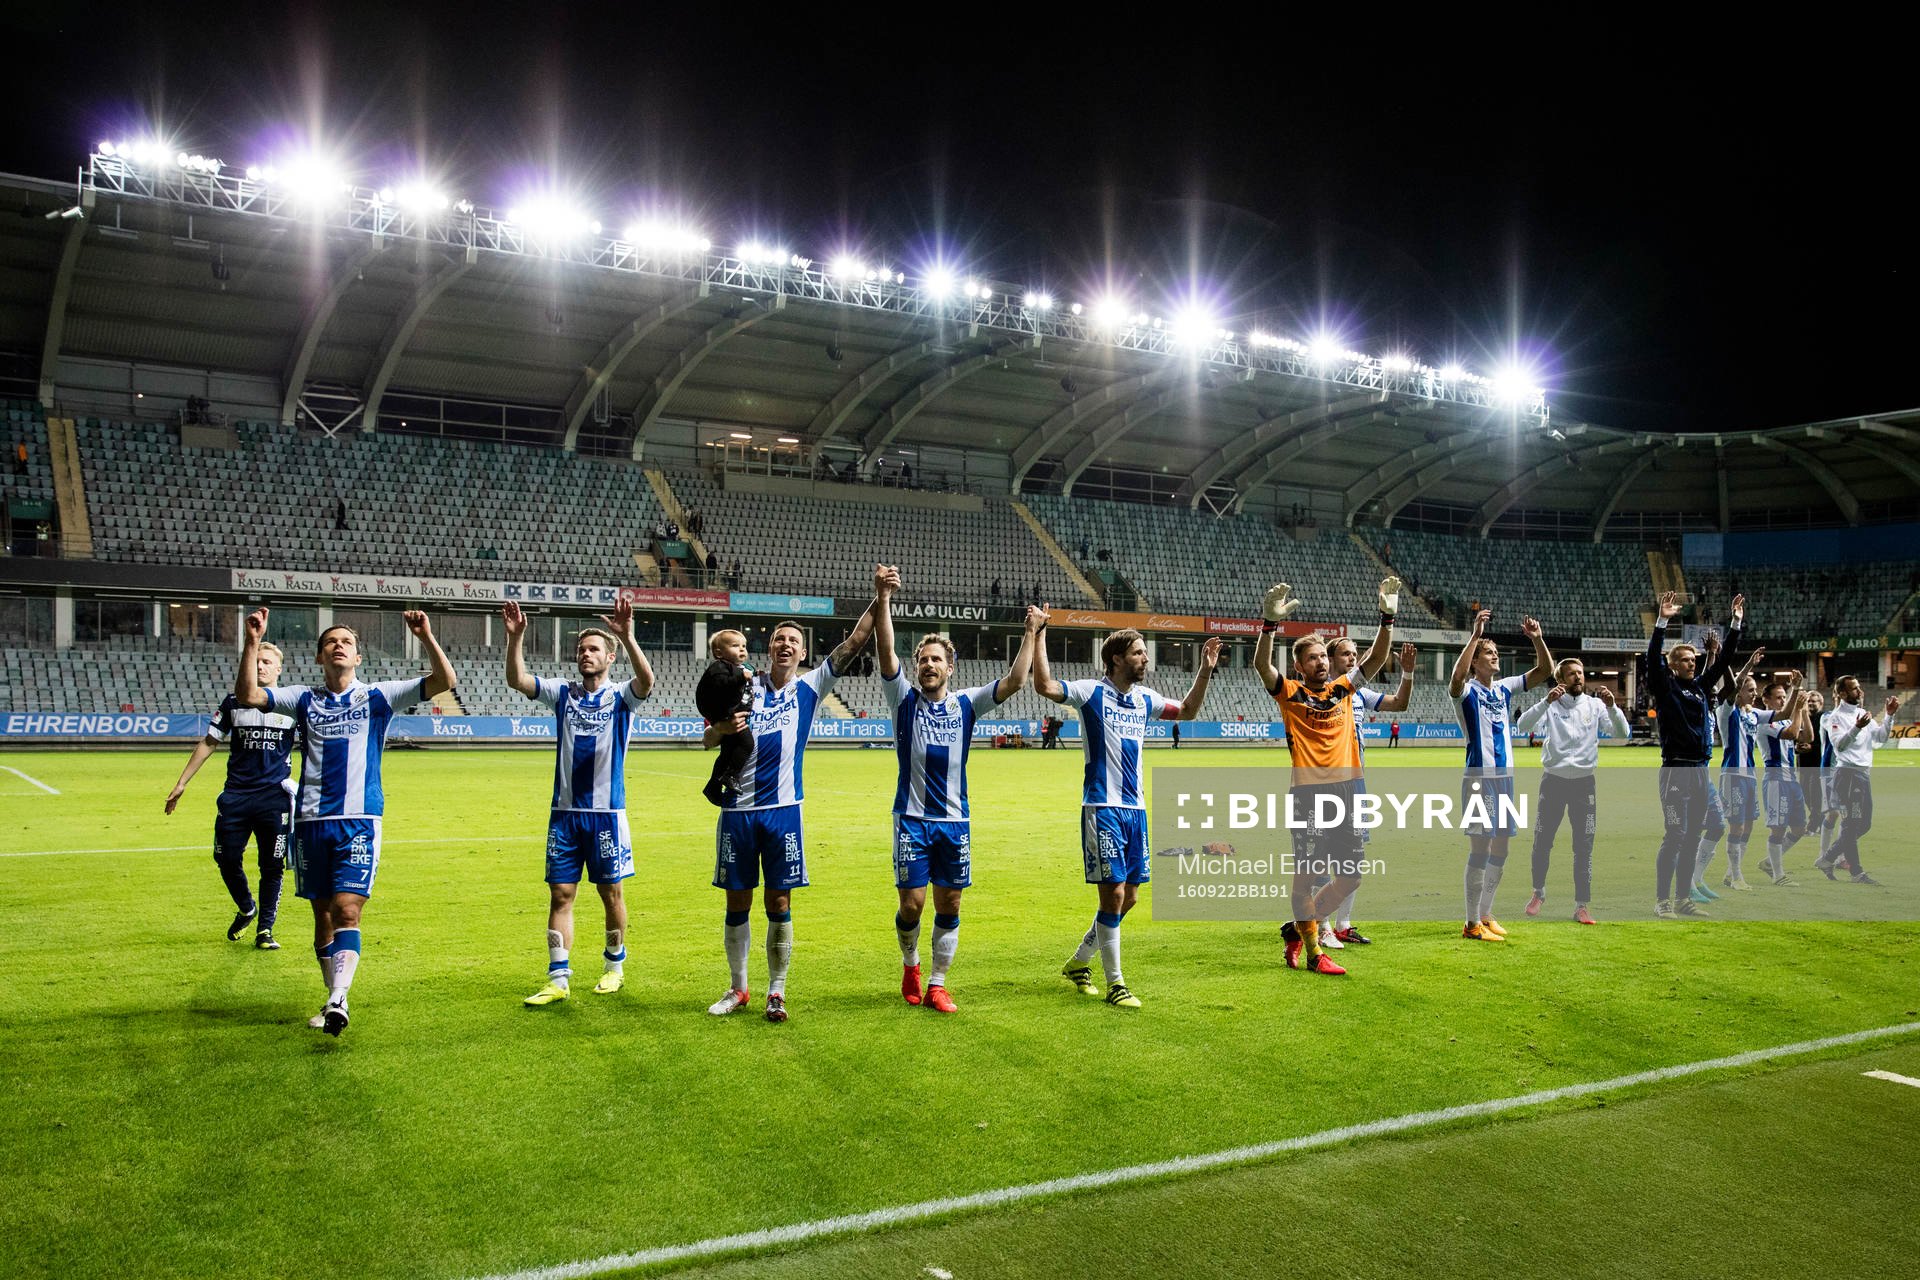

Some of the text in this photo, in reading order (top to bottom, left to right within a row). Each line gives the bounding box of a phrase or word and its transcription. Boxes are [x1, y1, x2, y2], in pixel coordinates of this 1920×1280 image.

[239, 578, 276, 589] RASTA
[286, 581, 323, 591] RASTA
[332, 583, 368, 593] RASTA
[377, 585, 412, 594] RASTA
[421, 587, 455, 597] RASTA
[464, 589, 497, 599] RASTA
[938, 606, 986, 620] ULLEVI
[1210, 622, 1220, 630] Det
[1222, 622, 1254, 633] nyckellösa
[308, 707, 368, 724] Prioritet
[750, 698, 796, 722] Prioet
[1104, 705, 1145, 725] Prioritet
[7, 715, 169, 733] EHRENBORG
[314, 723, 359, 736] Finans
[639, 719, 704, 736] Kappa
[812, 721, 886, 736] itet Finans
[238, 728, 284, 741] Prioritet
[433, 725, 473, 736] RASTA
[512, 725, 550, 736] RASTA
[1220, 723, 1271, 737] SERNEKE
[243, 739, 276, 750] Finans
[352, 835, 367, 845] SE
[599, 830, 611, 840] SE
[785, 832, 797, 843] SE
[900, 833, 911, 843] SE
[960, 834, 969, 844] SE
[1099, 830, 1112, 840] SE
[351, 845, 367, 854] RN
[600, 839, 614, 849] RN
[785, 842, 798, 852] RN
[1100, 839, 1114, 849] RN
[601, 847, 618, 859] EKE
[785, 850, 800, 862] EKE
[899, 852, 916, 861] EKE
[1100, 848, 1118, 858] EKE
[351, 854, 371, 865] EKE
[361, 869, 369, 881] 7
[789, 864, 801, 877] 11
